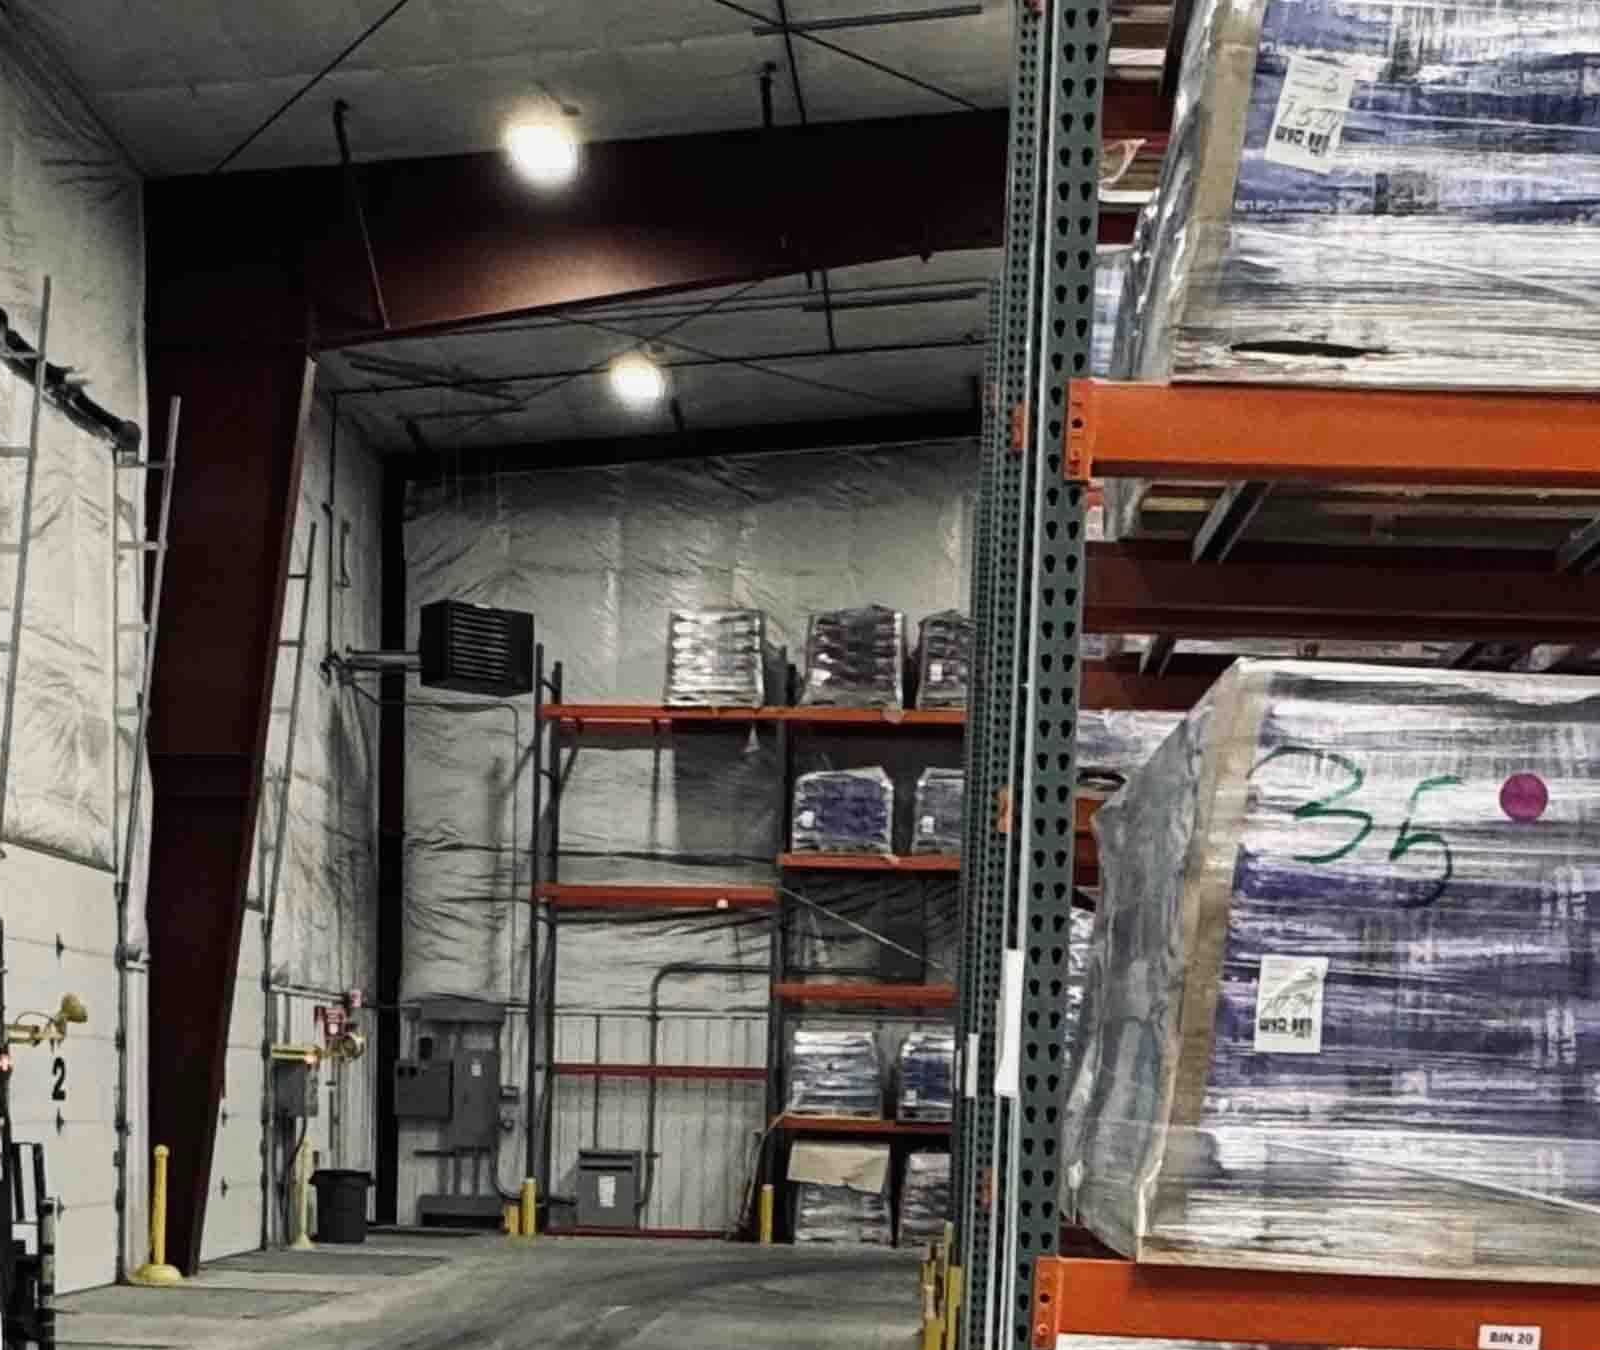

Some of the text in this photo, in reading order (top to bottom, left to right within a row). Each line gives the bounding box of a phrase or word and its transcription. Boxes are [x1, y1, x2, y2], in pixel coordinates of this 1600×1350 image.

[1246, 746, 1464, 908] 35
[52, 1056, 65, 1101] 2
[1490, 1331, 1534, 1345] BIN 20
